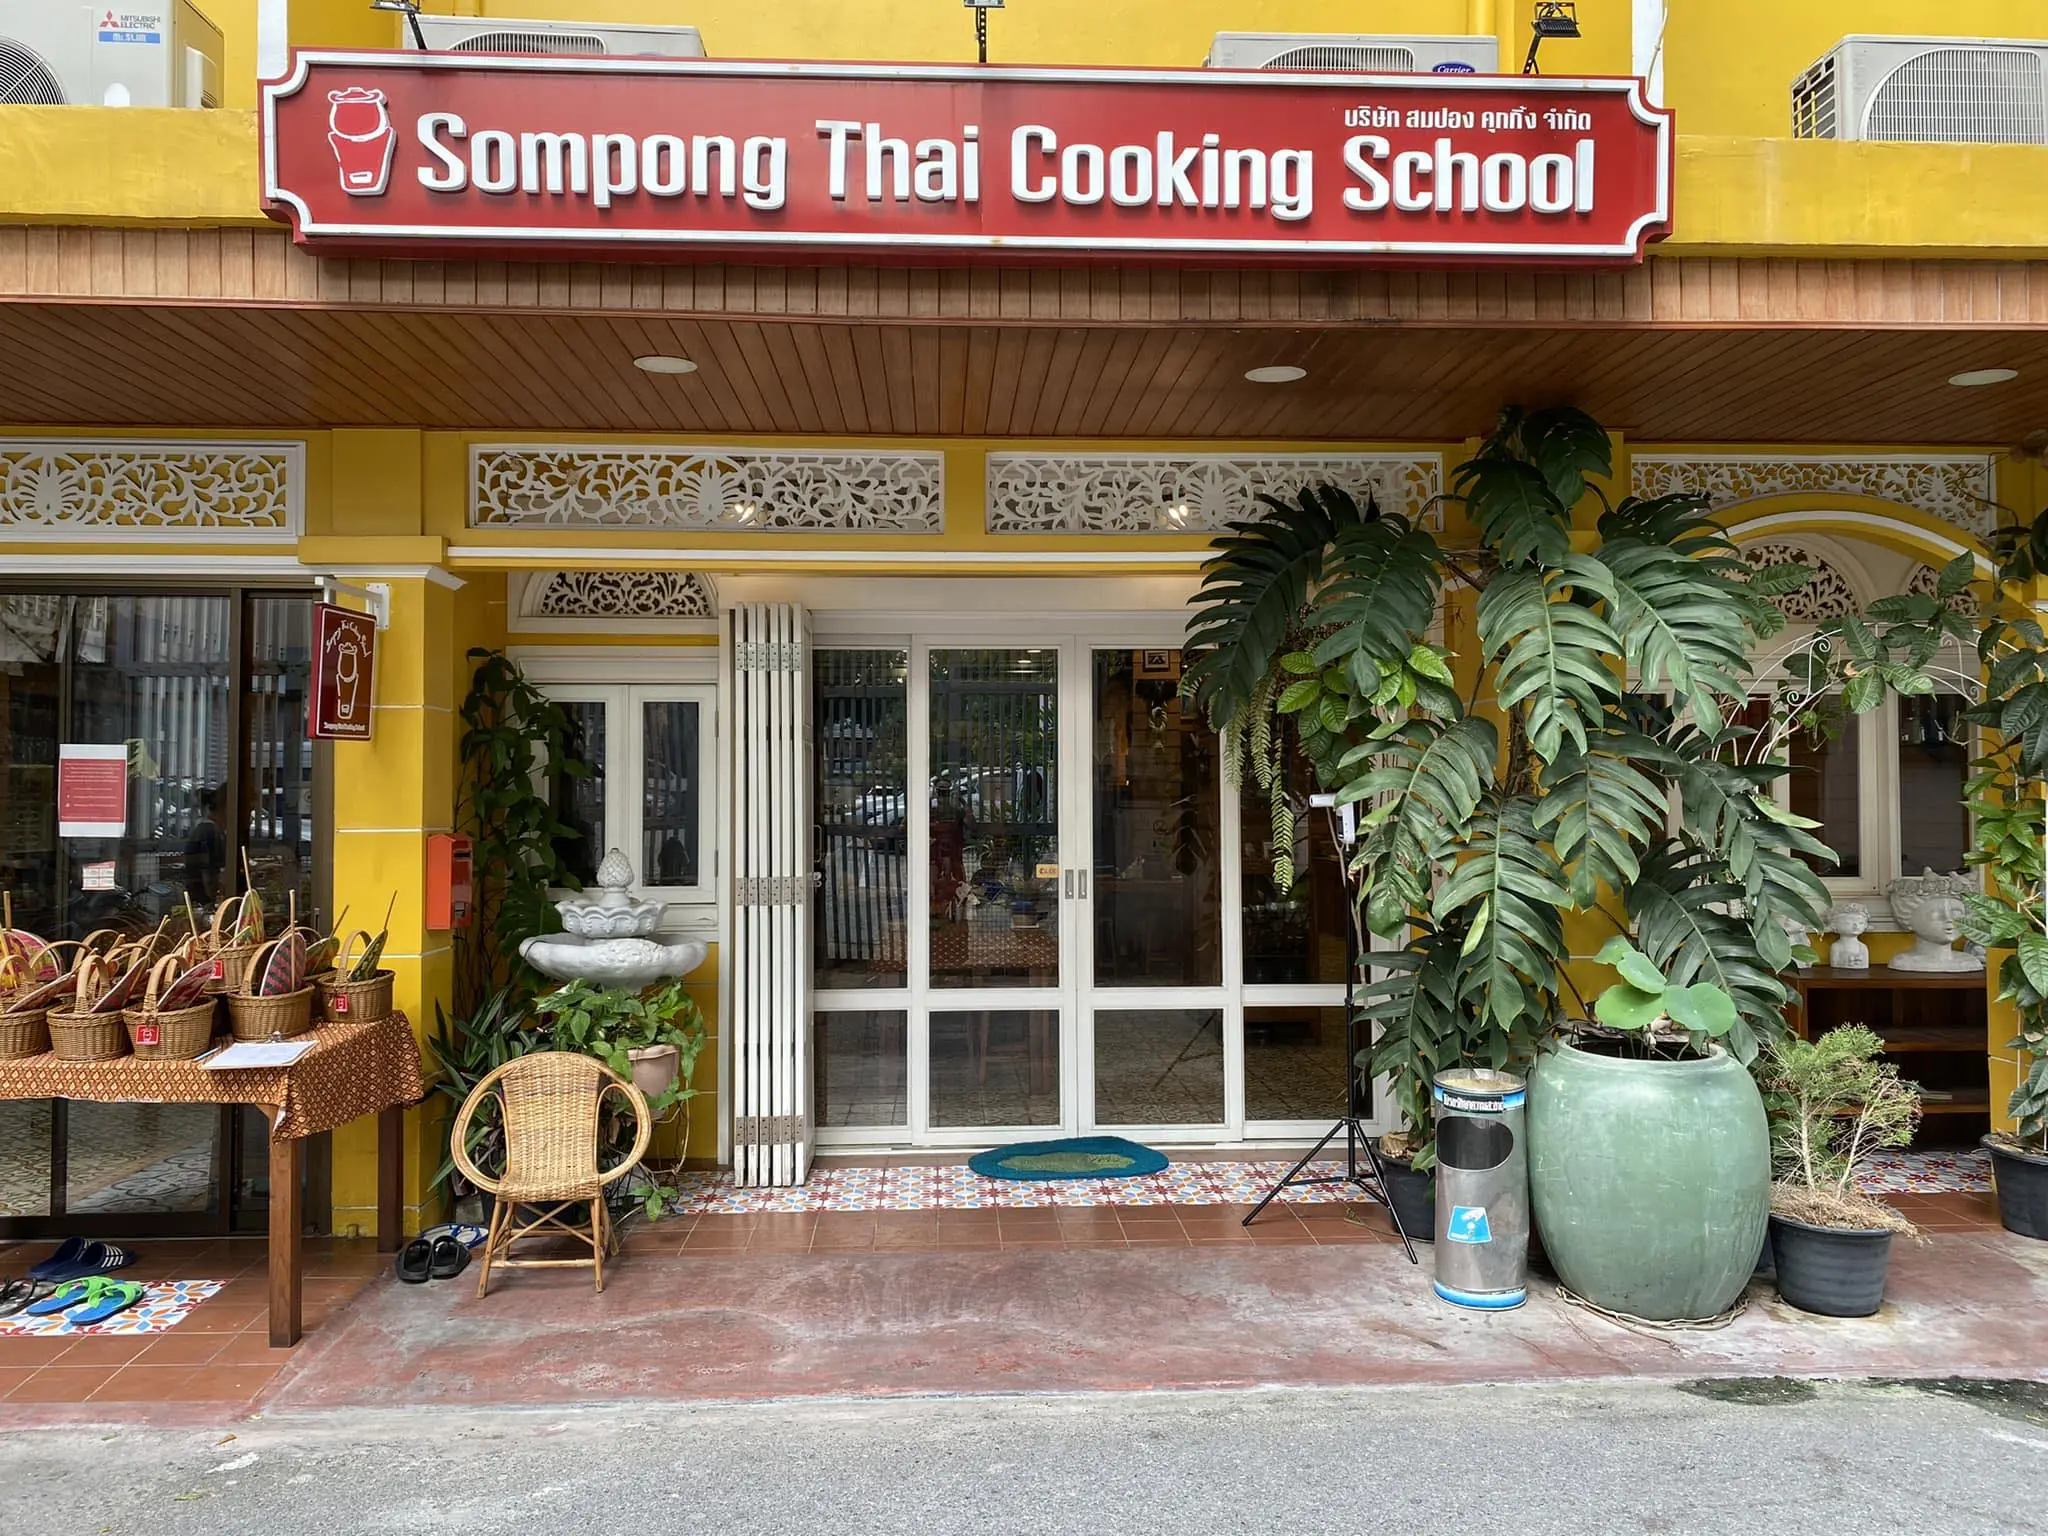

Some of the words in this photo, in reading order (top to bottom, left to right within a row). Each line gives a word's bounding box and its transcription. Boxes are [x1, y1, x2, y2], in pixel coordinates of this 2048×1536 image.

[120, 14, 161, 22] MITSUBISHI
[120, 21, 155, 29] ELECTRIC
[1344, 105, 1400, 128] บริษัท
[1406, 107, 1475, 130] สมปอง
[1481, 104, 1537, 134] คุกกิ้ง
[1543, 107, 1592, 131] จำกัด
[416, 111, 787, 210] Sompong
[814, 119, 980, 203] Thai
[1010, 124, 1314, 221] Cooking
[1342, 134, 1595, 214] School
